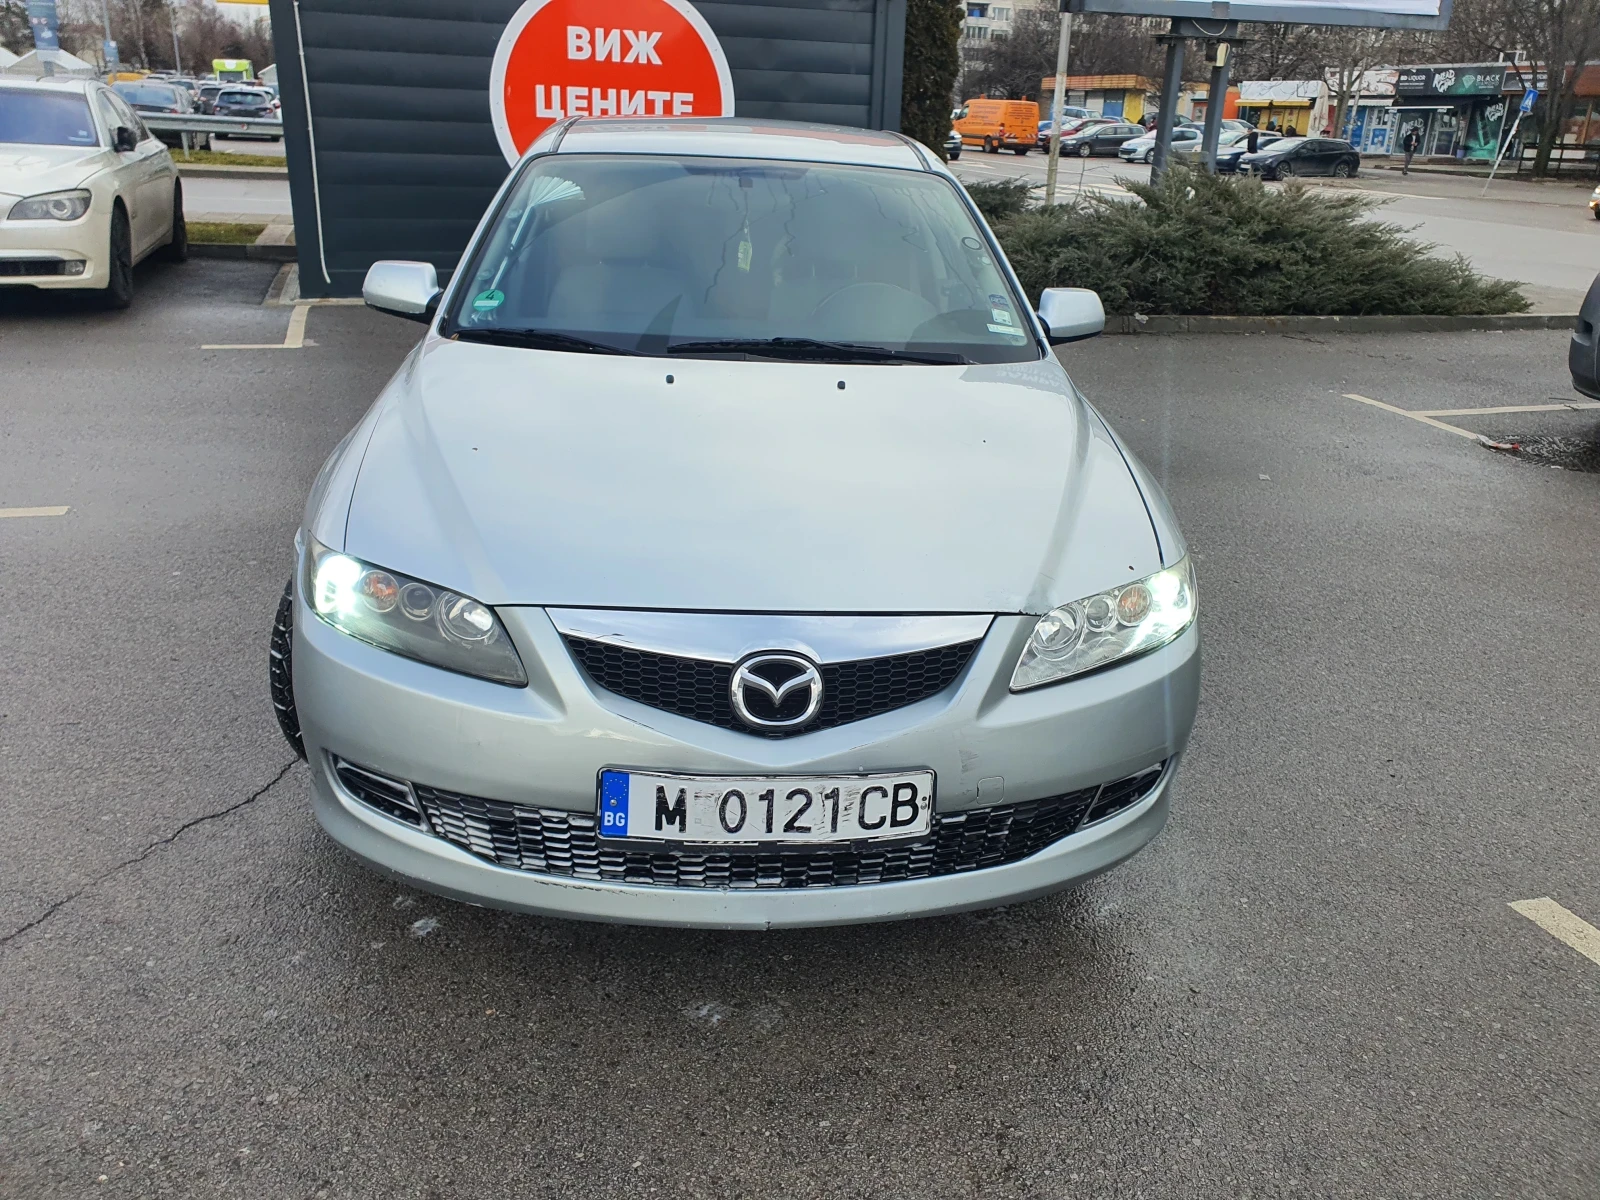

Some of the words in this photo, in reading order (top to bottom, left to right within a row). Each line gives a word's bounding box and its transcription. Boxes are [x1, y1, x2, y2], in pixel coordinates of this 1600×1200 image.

[566, 25, 663, 66] ВИЖ
[1476, 74, 1500, 82] BLACK
[535, 84, 694, 120] ЦЕНИТЕ
[603, 811, 626, 827] BG
[654, 784, 687, 833] M
[718, 786, 840, 834] 0121
[858, 782, 919, 830] CB
